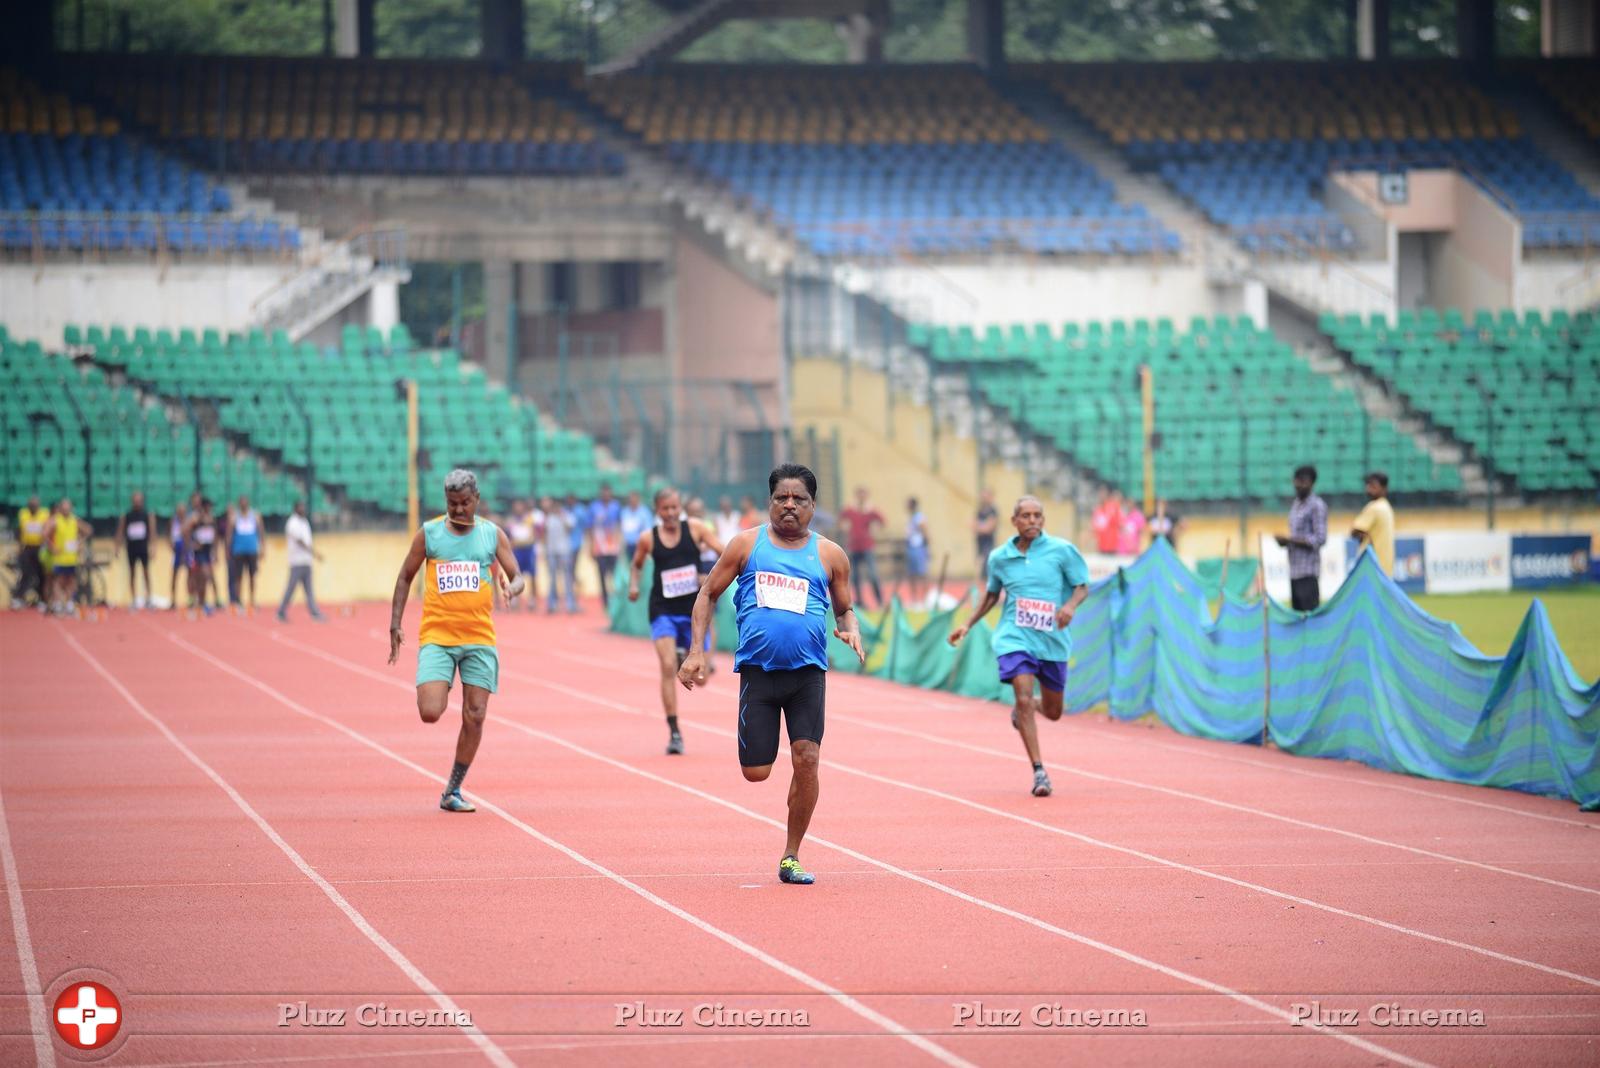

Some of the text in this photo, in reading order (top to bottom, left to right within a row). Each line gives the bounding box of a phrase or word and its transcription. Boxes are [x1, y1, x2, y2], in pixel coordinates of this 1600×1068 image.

[438, 563, 478, 574] CDMAA
[439, 575, 479, 591] 55019
[758, 573, 806, 593] CDMAA
[1018, 599, 1053, 612] CDMAA
[1018, 610, 1053, 628] 55014
